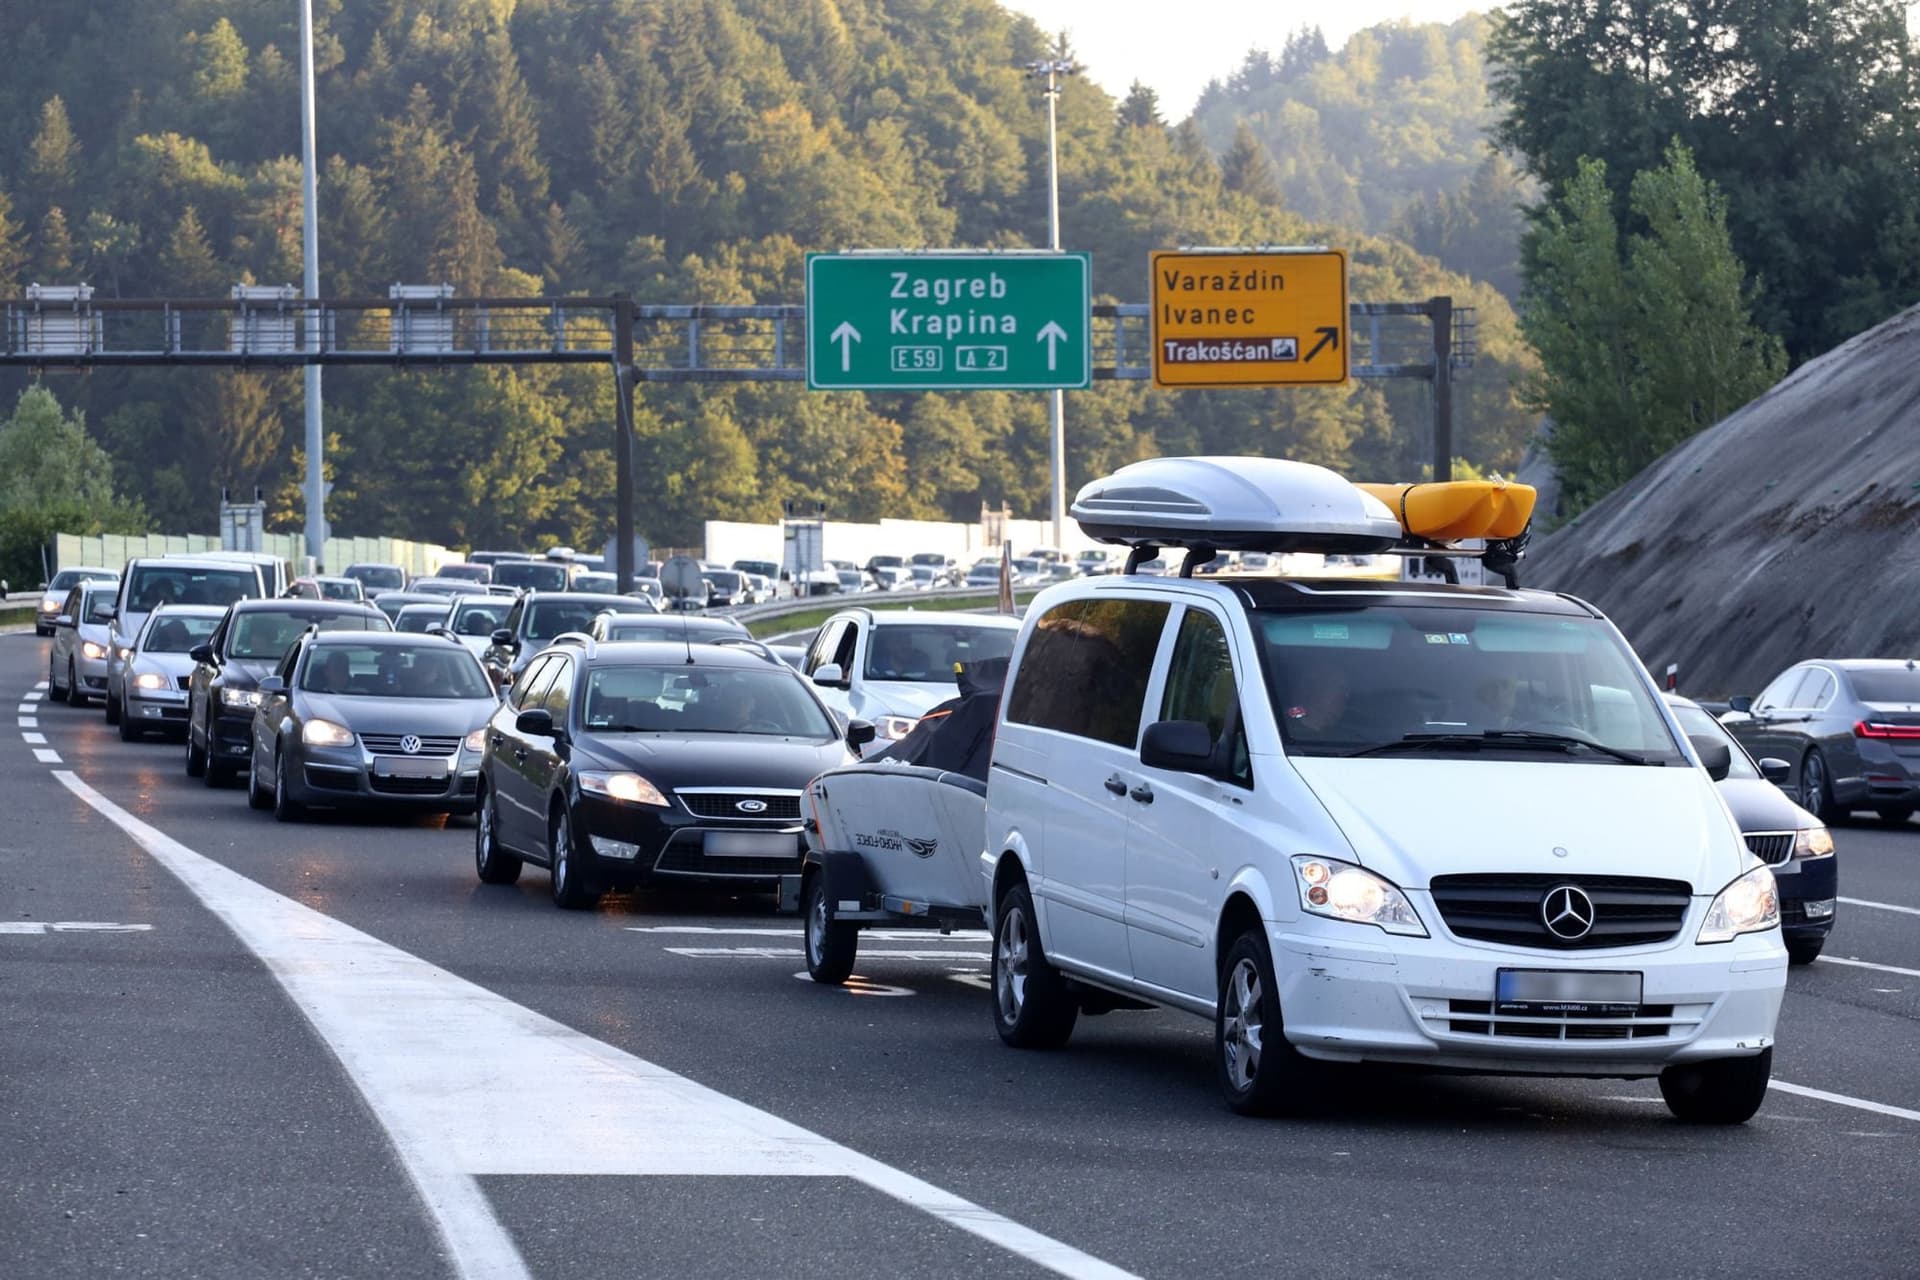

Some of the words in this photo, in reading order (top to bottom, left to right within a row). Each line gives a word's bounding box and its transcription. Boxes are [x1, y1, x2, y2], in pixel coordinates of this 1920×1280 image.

[890, 272, 1006, 305] Zagreb
[1164, 270, 1284, 291] Varaždin
[890, 308, 1017, 340] Krapina
[1164, 303, 1255, 325] Ivanec
[898, 350, 908, 368] E
[913, 350, 936, 368] 59
[966, 350, 976, 368] A
[988, 350, 998, 368] 2
[1164, 341, 1270, 361] Trakošćan
